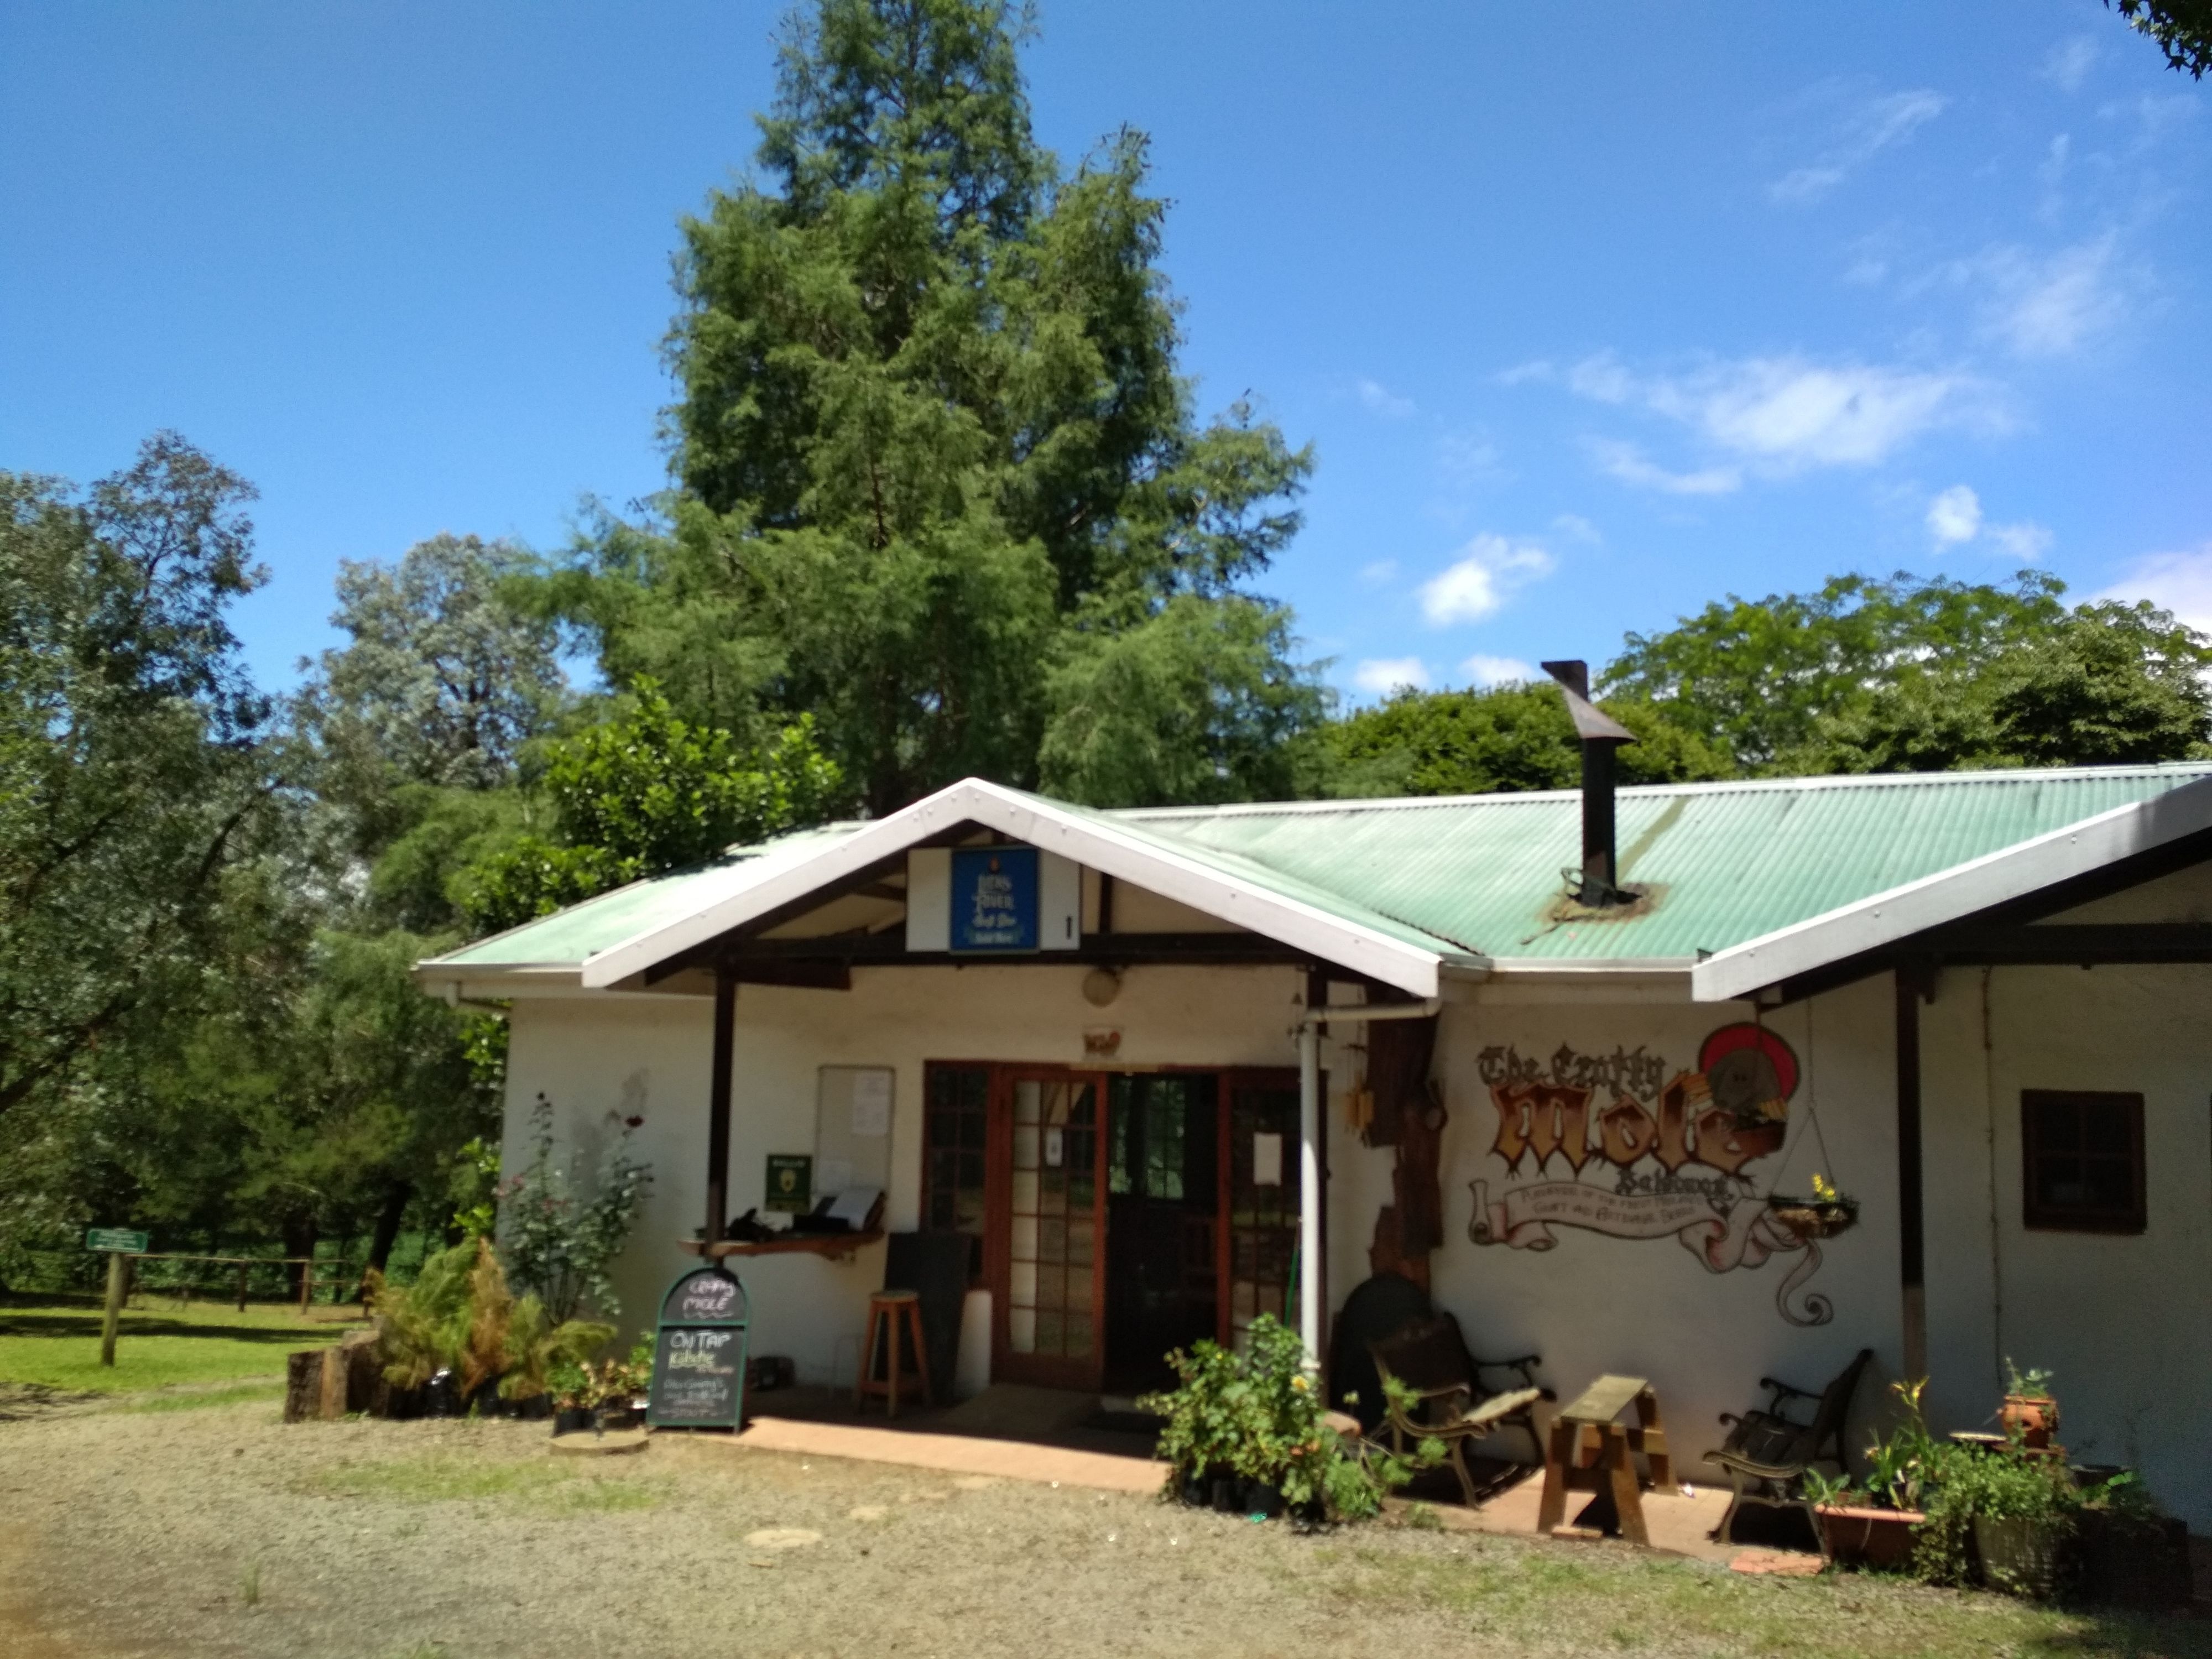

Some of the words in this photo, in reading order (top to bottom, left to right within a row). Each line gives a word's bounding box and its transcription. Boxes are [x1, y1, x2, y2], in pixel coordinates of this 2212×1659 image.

[1476, 1046, 1550, 1086] The
[1550, 1041, 1666, 1102] Crafty
[1488, 1070, 1787, 1181] Mole
[670, 1331, 695, 1348] ON
[696, 1330, 732, 1349] TAP
